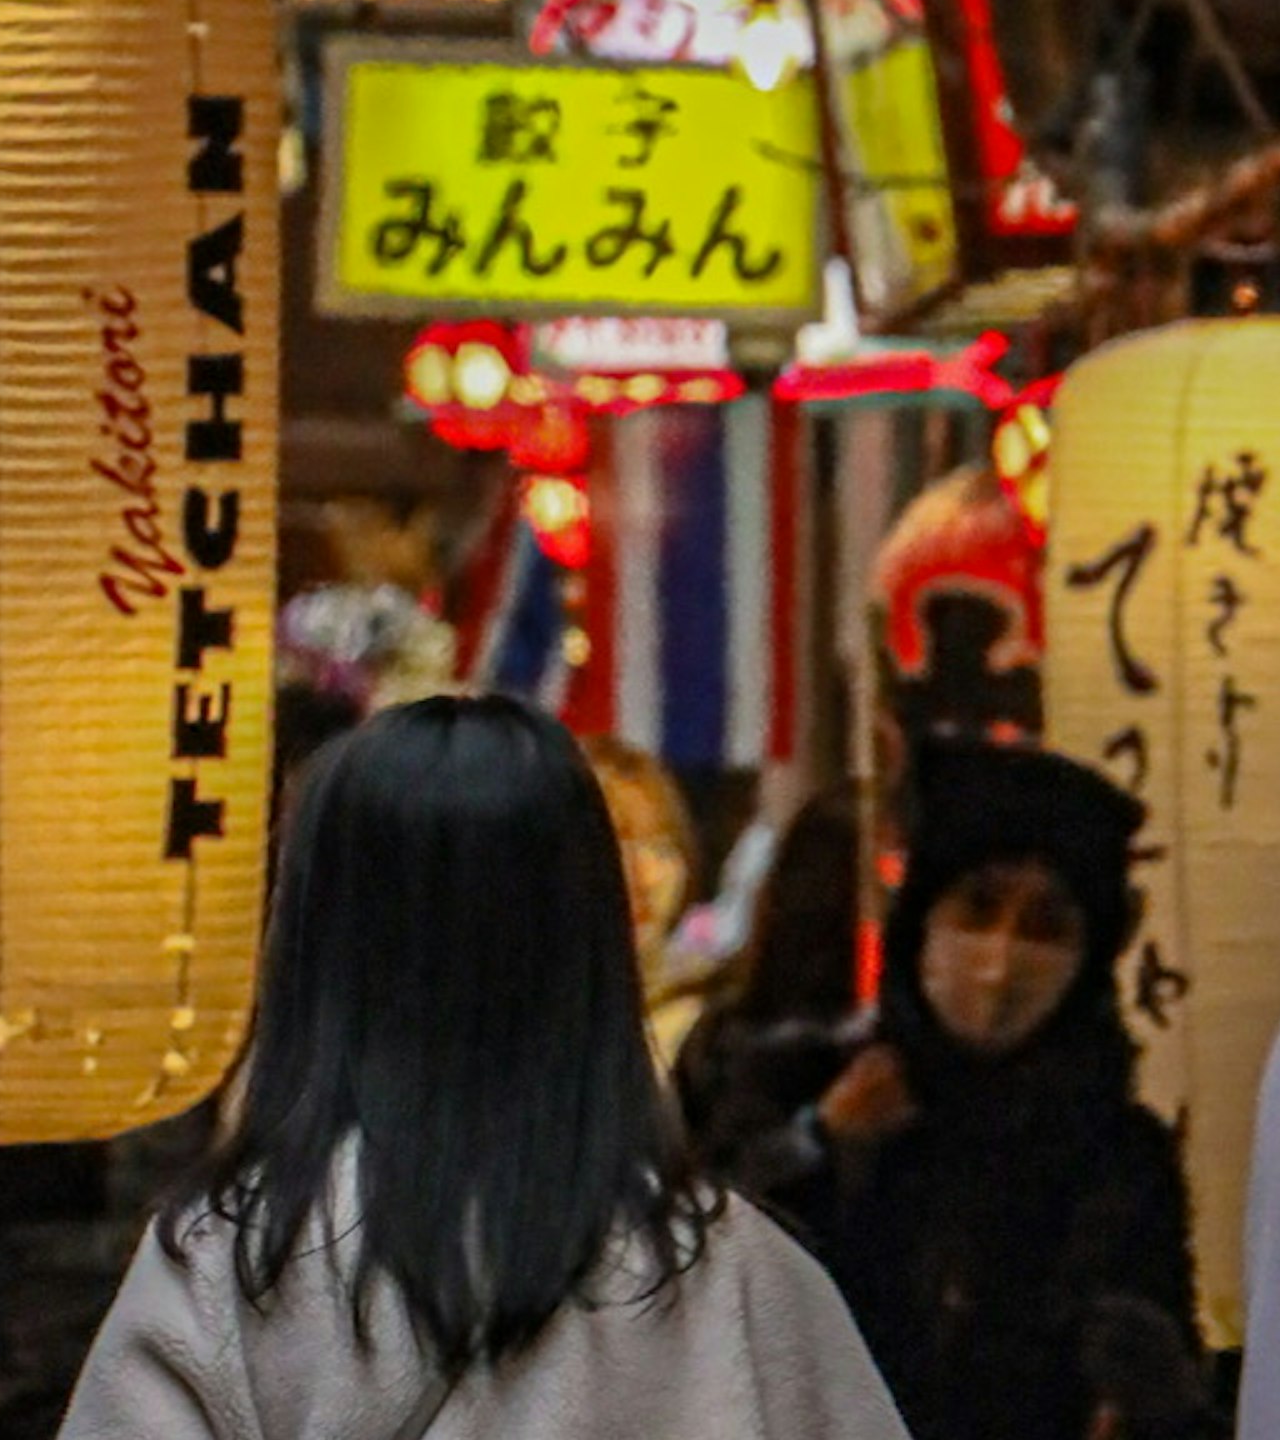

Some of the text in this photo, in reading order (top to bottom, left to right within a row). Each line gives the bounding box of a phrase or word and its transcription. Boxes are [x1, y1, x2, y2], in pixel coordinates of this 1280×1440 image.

[370, 177, 784, 283] みんみん
[476, 88, 680, 167] 餃子
[81, 284, 186, 616] Yakitori
[162, 94, 245, 861] TETCHAN
